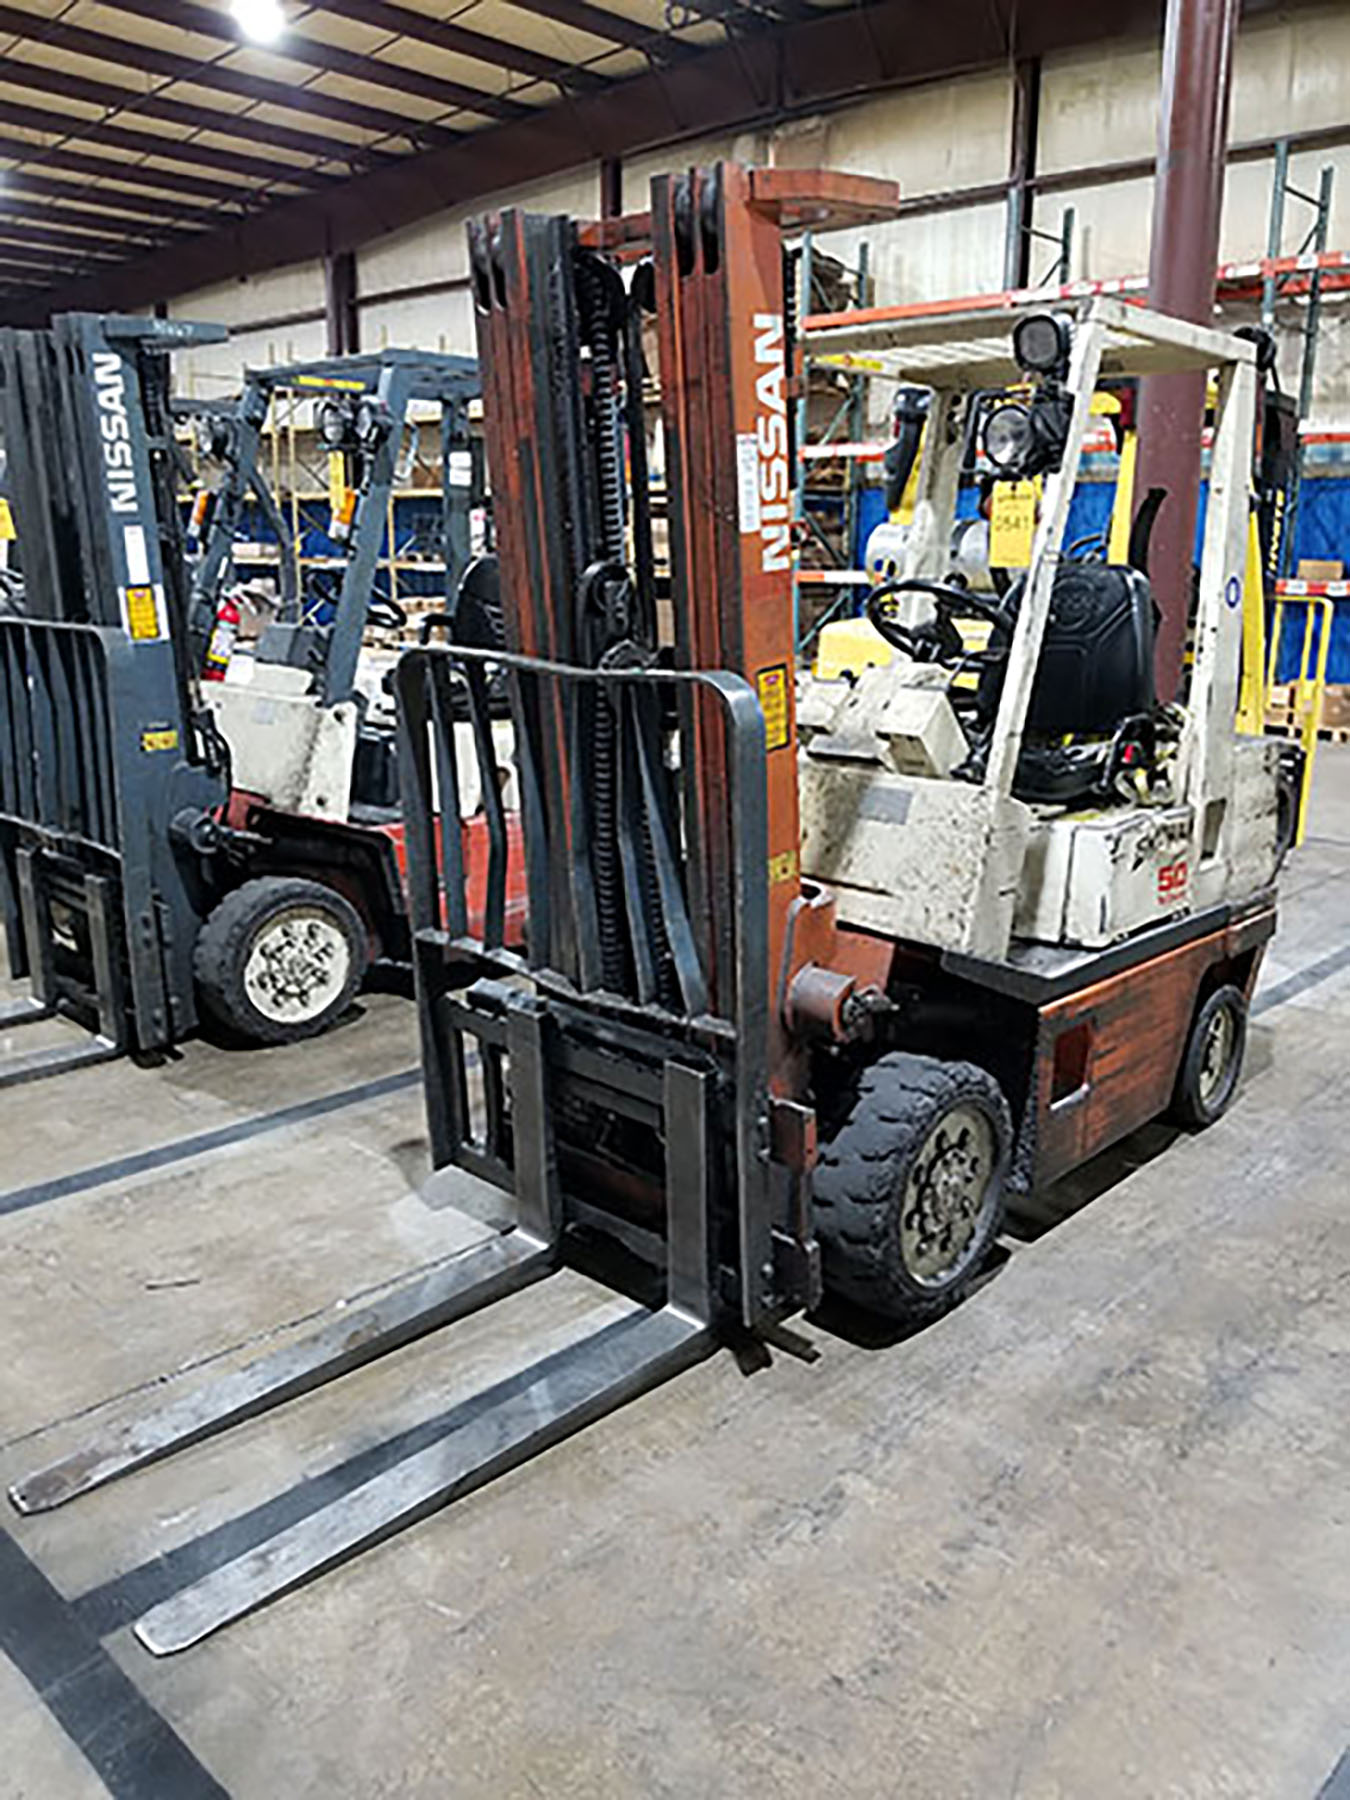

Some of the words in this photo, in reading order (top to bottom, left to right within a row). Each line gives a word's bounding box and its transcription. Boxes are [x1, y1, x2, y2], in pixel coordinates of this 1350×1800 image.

[92, 352, 138, 513] NISSAN
[753, 313, 790, 572] NISSAN
[1158, 862, 1188, 892] 50
